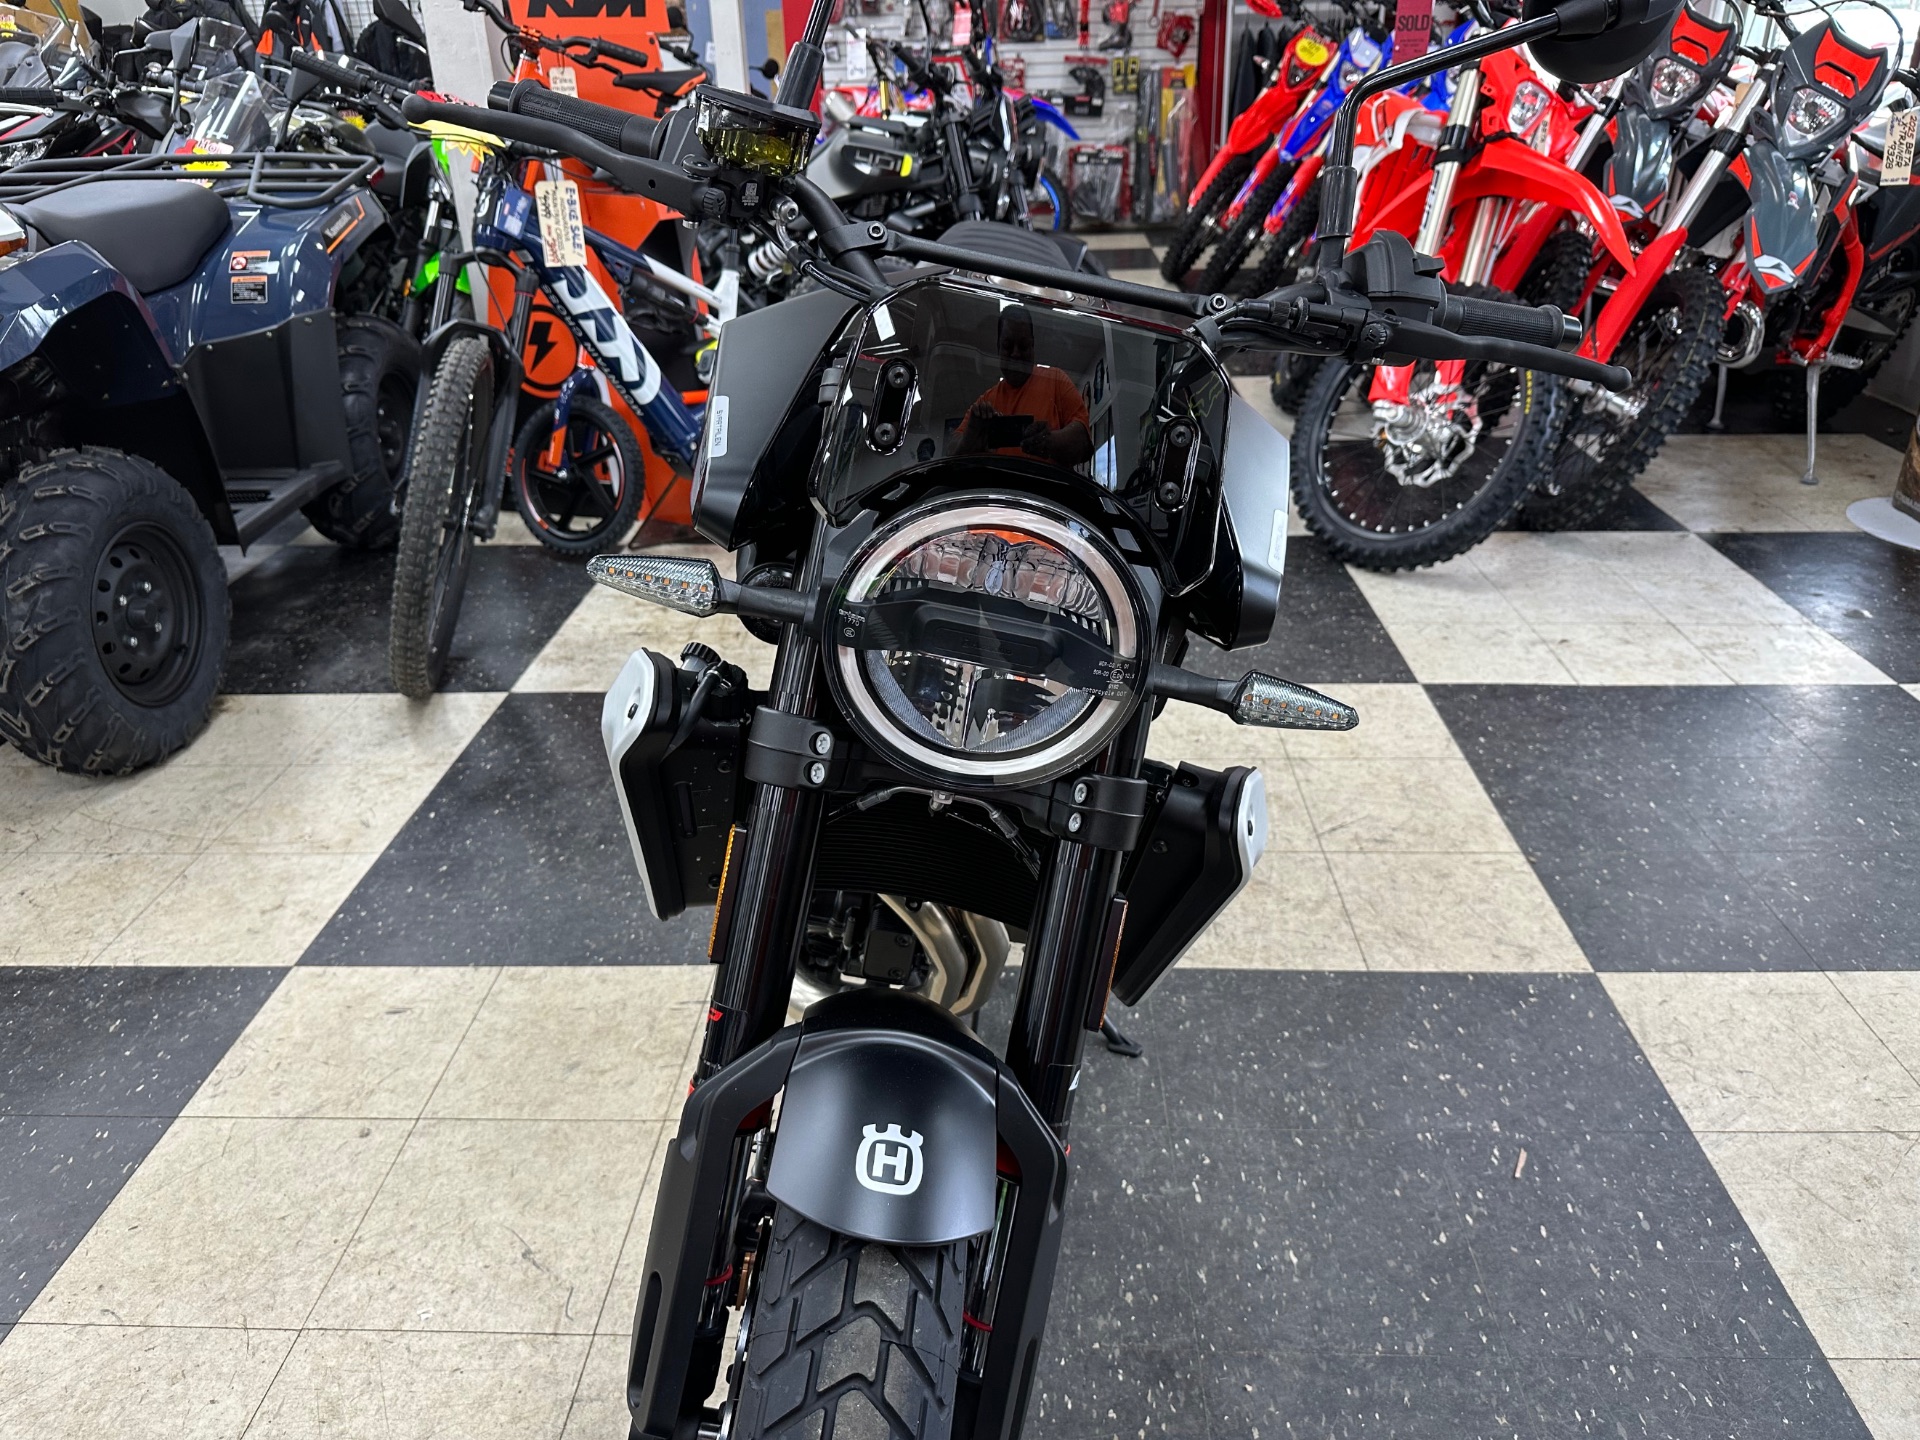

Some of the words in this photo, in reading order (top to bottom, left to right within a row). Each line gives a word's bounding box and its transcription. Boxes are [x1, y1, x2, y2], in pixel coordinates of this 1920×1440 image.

[1397, 14, 1431, 32] SOLD
[1906, 115, 1917, 140] 2025
[1894, 121, 1908, 168] X-TRAINER
[1903, 142, 1914, 167] BETA
[541, 283, 584, 338] CROSS
[585, 341, 645, 417] MOUNTAIN
[844, 616, 860, 627] 1770
